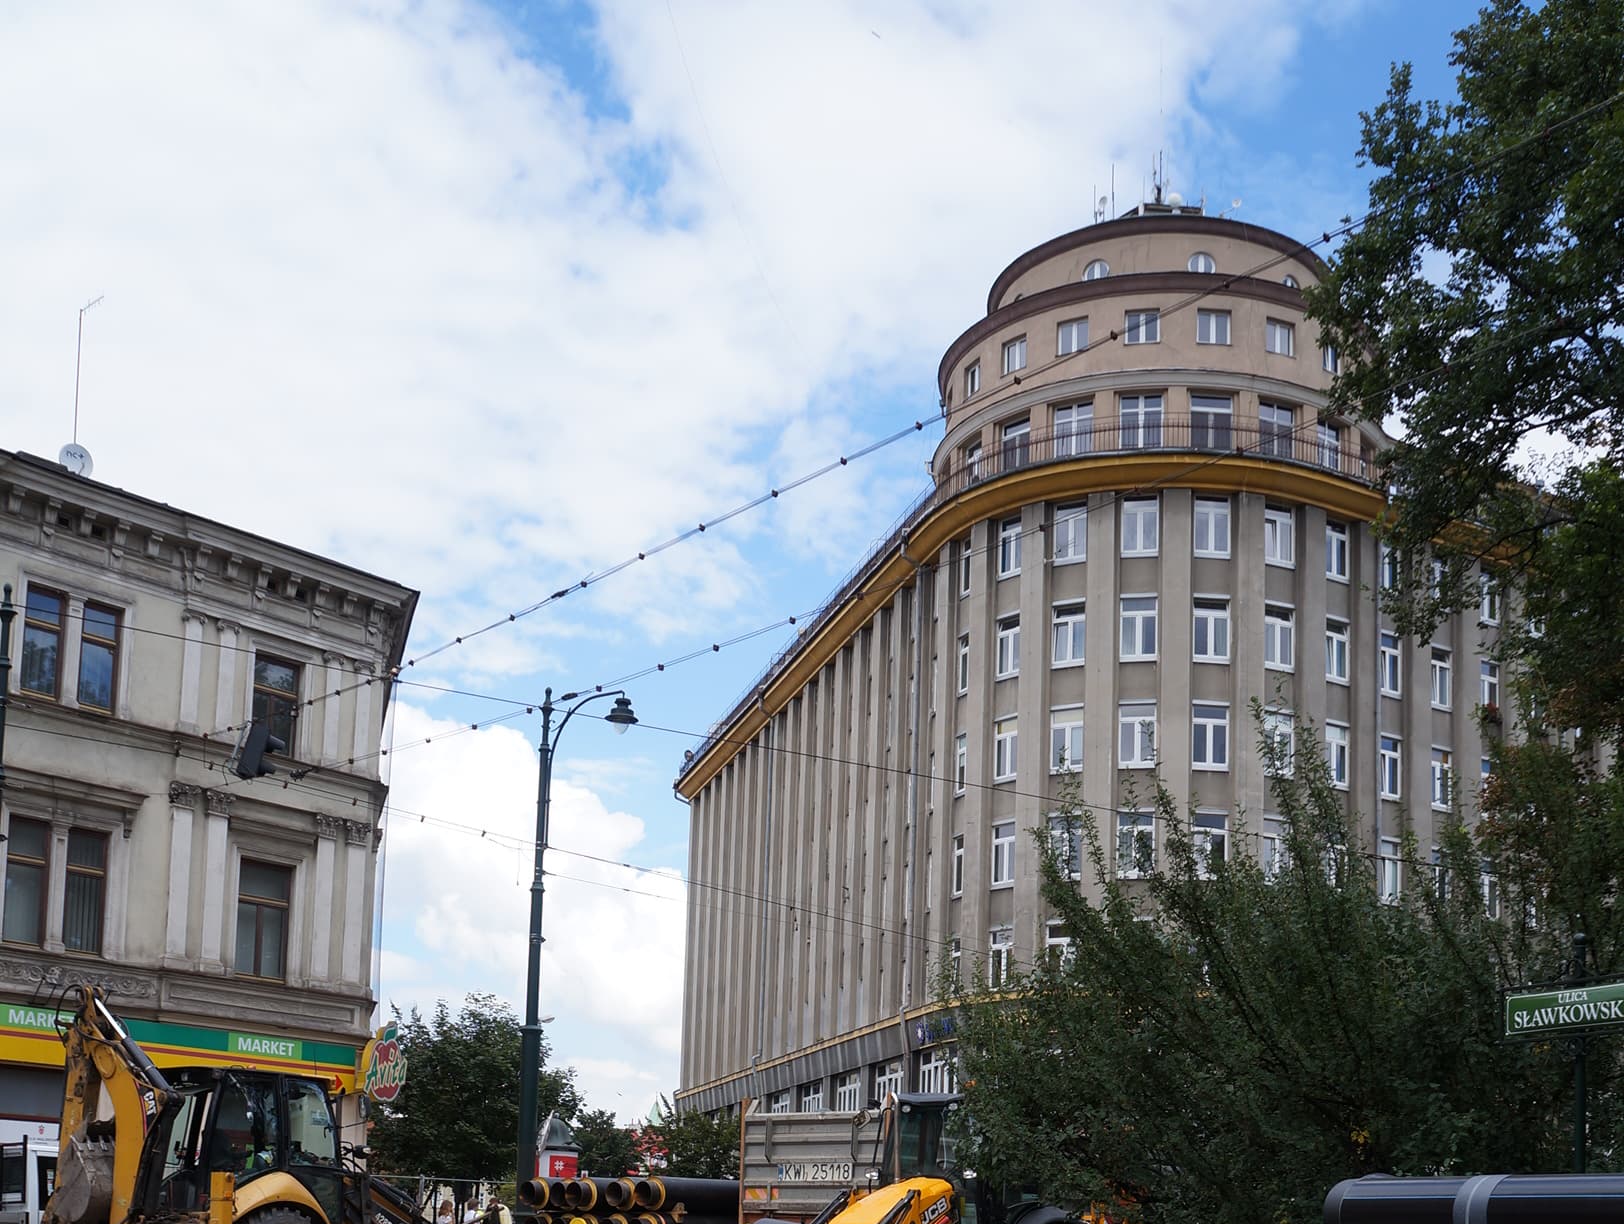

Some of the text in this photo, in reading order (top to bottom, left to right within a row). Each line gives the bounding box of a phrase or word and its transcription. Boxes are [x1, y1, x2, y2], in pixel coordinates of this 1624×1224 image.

[1558, 991, 1588, 1003] ULICA
[238, 1037, 295, 1057] MARKET
[364, 1048, 408, 1093] Avita
[143, 1090, 157, 1117] CAT
[784, 1164, 806, 1180] KWI
[812, 1163, 850, 1180] 25118
